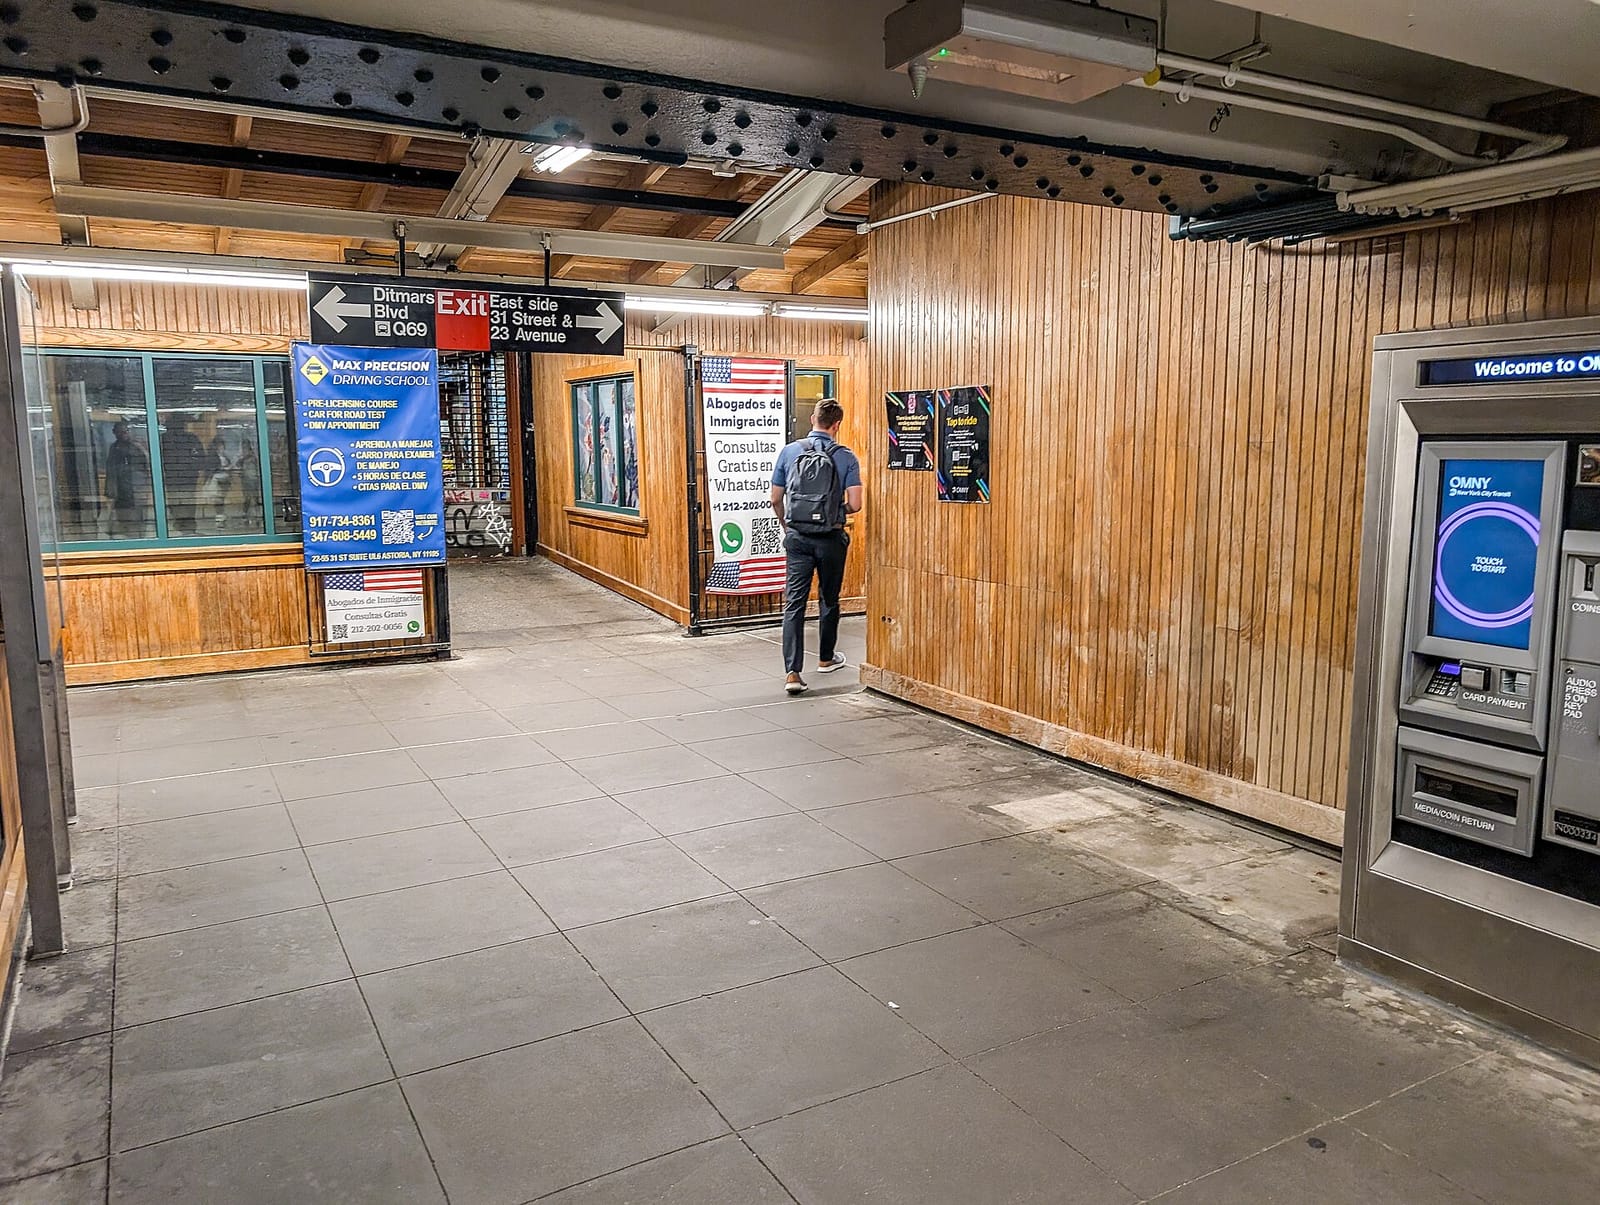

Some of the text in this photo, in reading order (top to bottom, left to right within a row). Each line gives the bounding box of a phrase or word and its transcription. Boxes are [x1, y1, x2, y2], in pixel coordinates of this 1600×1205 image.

[373, 287, 434, 304] Ditmars
[437, 291, 488, 316] Exit
[490, 294, 558, 312] East side
[374, 304, 408, 319] Blvd
[490, 310, 573, 328] 31 Street &
[393, 322, 428, 336] Q69
[490, 326, 566, 343] 23 Avenue
[332, 360, 430, 372] MAX PRECISION
[1475, 361, 1553, 376] Welcome
[1556, 358, 1576, 372] to
[333, 374, 431, 386] DRIVING SCHOOL
[308, 400, 398, 408] PRE-LICENSING COURSE
[706, 397, 782, 412] Abogados de
[327, 421, 380, 429] APPOINTMENT
[710, 415, 779, 429] Inmigración
[355, 440, 391, 448] APRENDA
[399, 440, 433, 448] MANEJAR
[714, 440, 776, 454] Consultas
[356, 451, 383, 459] CARRO
[718, 459, 773, 472] Gratis en
[358, 472, 362, 480] 5
[363, 472, 389, 480] HORAS
[391, 472, 401, 480] DE
[358, 483, 380, 491] CITAS
[402, 482, 411, 490] EL
[412, 482, 428, 490] DMV
[714, 478, 770, 493] WhatsAp
[1449, 476, 1492, 489] OMNY
[722, 501, 772, 511] 212-202-00
[309, 515, 375, 527] 917-734-8361
[310, 530, 377, 542] 347-608-5449
[349, 553, 368, 561] SUITE
[1475, 556, 1503, 565] TOUCH
[1482, 565, 1507, 574] START
[327, 597, 365, 607] Abogados
[344, 610, 408, 621] Consultas Gratis
[1566, 677, 1596, 688] AUDIO
[1565, 685, 1597, 697] PRESS
[1462, 692, 1527, 710] CARD PAYMENT
[1565, 693, 1588, 703] 5 ON
[1564, 701, 1584, 710] KEY
[1563, 709, 1583, 718] PAD
[1414, 802, 1495, 831] MEDIA/COIN RETURN
